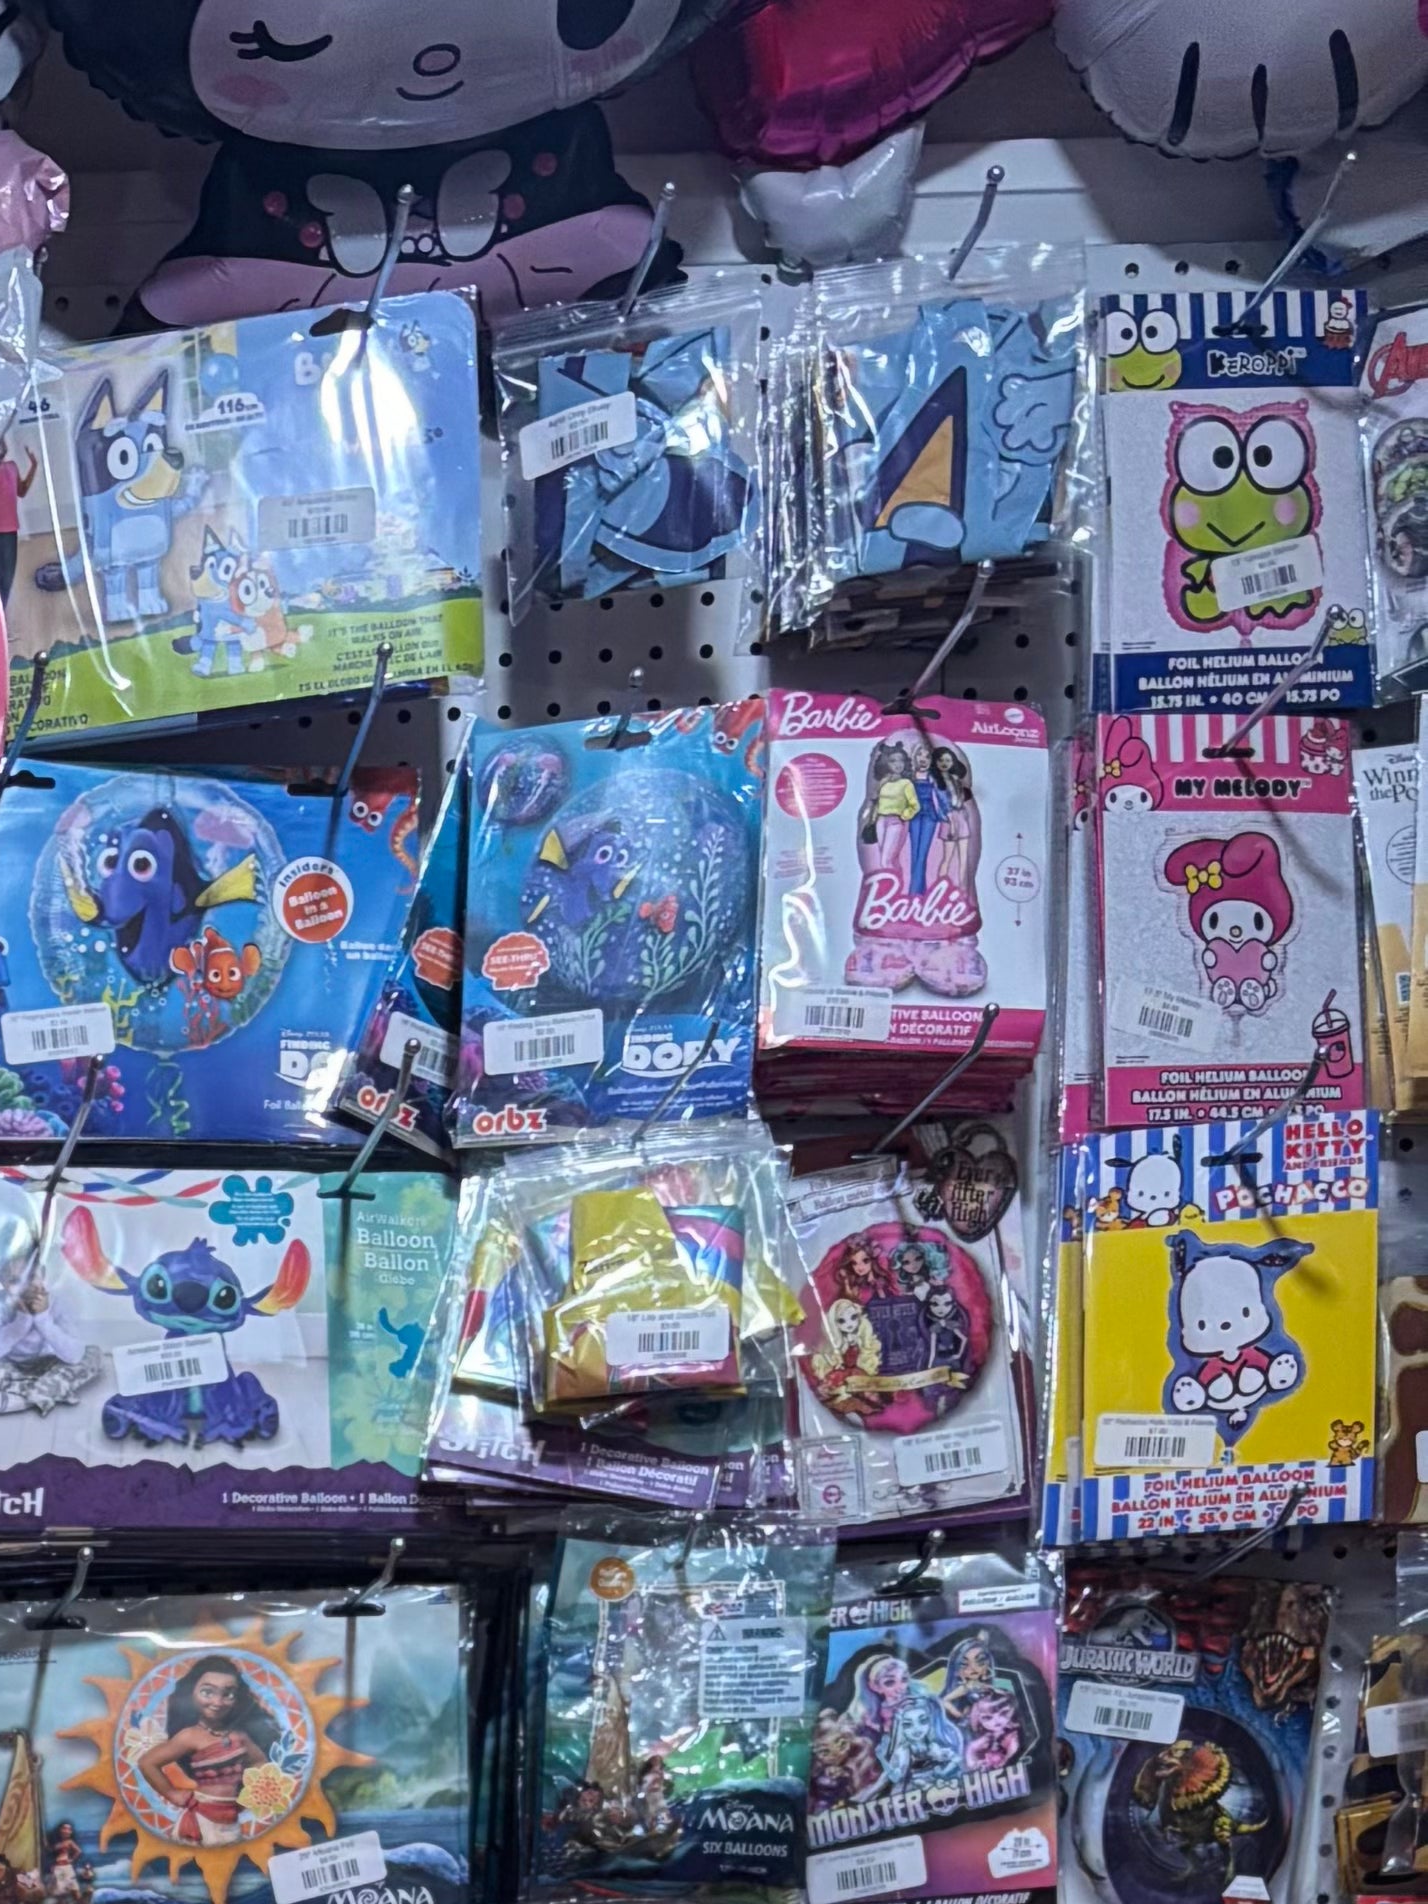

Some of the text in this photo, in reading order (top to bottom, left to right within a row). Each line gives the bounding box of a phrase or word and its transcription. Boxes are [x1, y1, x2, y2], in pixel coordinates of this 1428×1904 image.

[1168, 653, 1254, 671] FOIL HELIUM
[1139, 671, 1271, 691] BALLON HÉLIUM EN
[1222, 692, 1243, 706] 40
[780, 691, 882, 736] Barbie
[1174, 776, 1302, 799] MY MELODY
[1370, 786, 1393, 801] the
[288, 886, 338, 908] Balloon
[861, 873, 978, 929] Barbie
[294, 909, 343, 931] Balloon
[921, 1009, 984, 1023] BALLOON
[900, 1021, 973, 1037] DÉCORATIF
[280, 1039, 331, 1051] FINDING
[622, 1036, 742, 1071] DORY
[1160, 1070, 1245, 1085] FOIL HELIUM
[1132, 1085, 1261, 1104] BALLON HÉLIUM EN
[357, 1085, 420, 1132] orz
[1241, 1106, 1264, 1119] CM
[473, 1104, 547, 1136] orbz
[1285, 1119, 1364, 1141] HELLO
[1285, 1140, 1365, 1160] KITTY
[1216, 1177, 1368, 1212] POCHACCO
[356, 1227, 436, 1250] Balloon
[363, 1252, 429, 1272] Ballon
[590, 1443, 709, 1475] Decorative Balloon
[596, 1458, 636, 1476] Ballon
[638, 1465, 698, 1487] Décoratif
[1145, 1469, 1315, 1494] FOIL HELIUM BALLOON
[232, 1492, 408, 1505] Decorative Balloon Ballon
[1111, 1490, 1255, 1514] BALLON HÉLIUM EN
[1138, 1516, 1155, 1529] 22
[1232, 1509, 1256, 1523] CM
[868, 1599, 913, 1623] HIGH
[1061, 1647, 1195, 1679] JURASSIC WORLD
[806, 1762, 1031, 1849] MONSTER HIGH
[697, 1807, 794, 1834] MOANA
[702, 1841, 787, 1857] SIX BALLOONS
